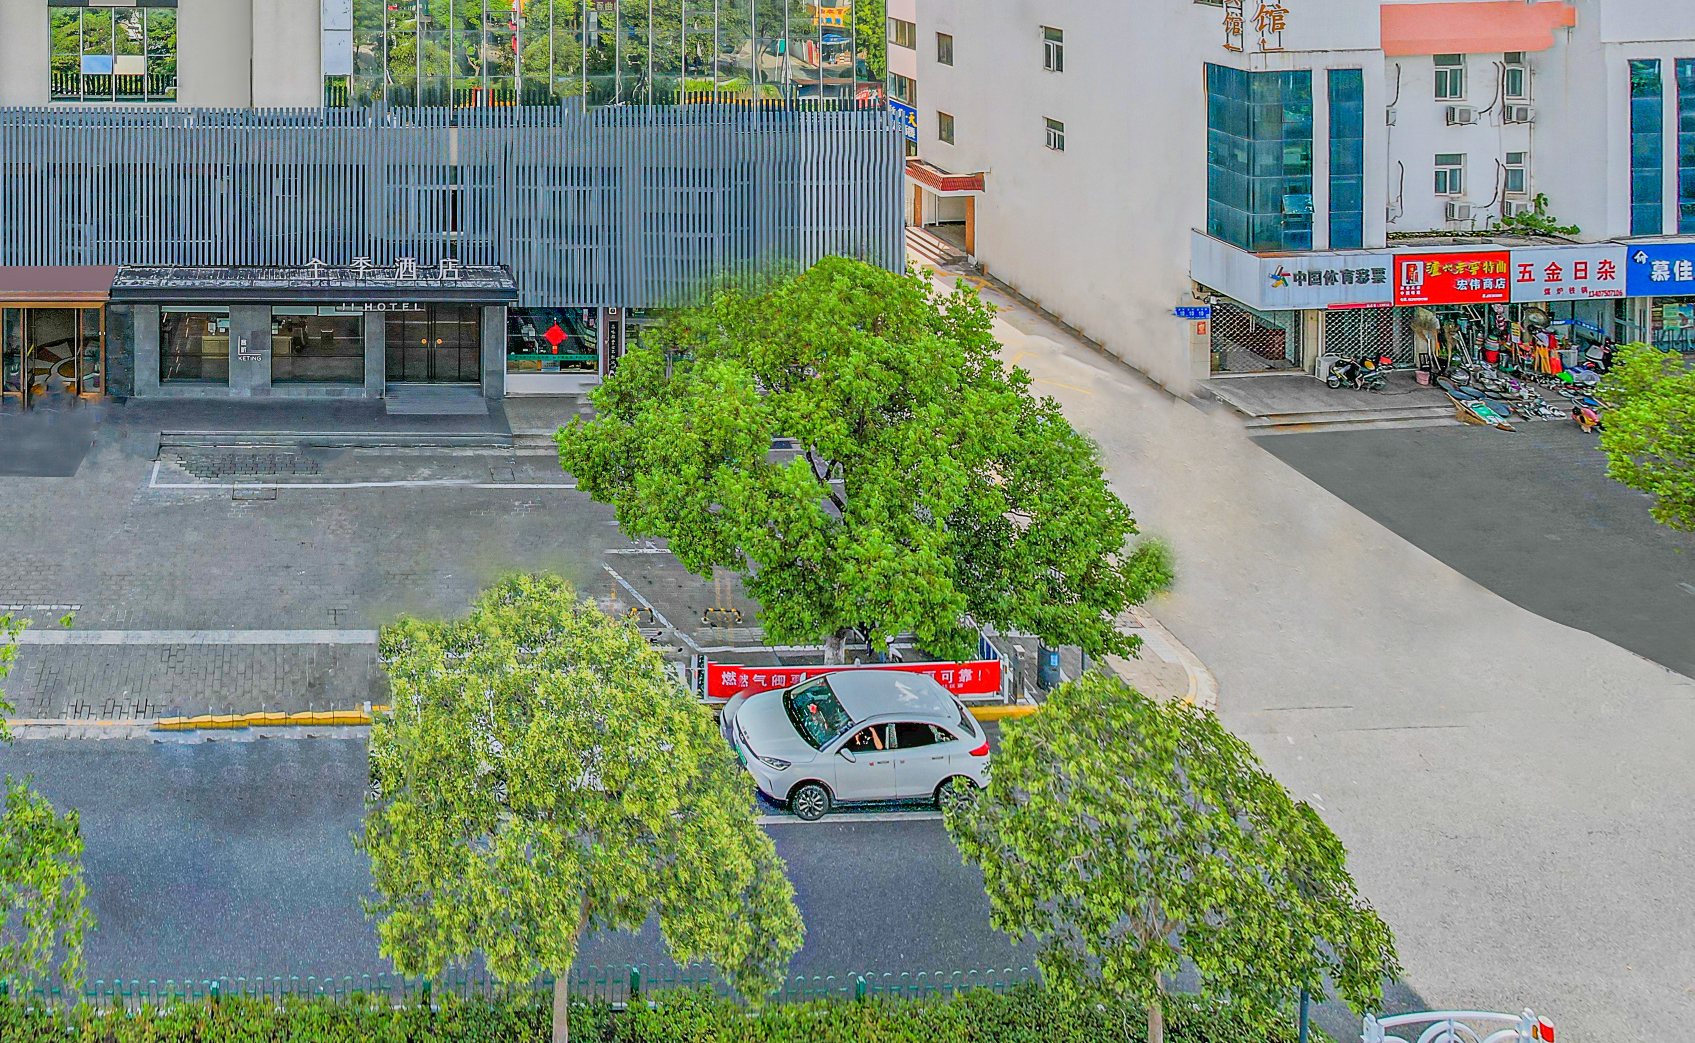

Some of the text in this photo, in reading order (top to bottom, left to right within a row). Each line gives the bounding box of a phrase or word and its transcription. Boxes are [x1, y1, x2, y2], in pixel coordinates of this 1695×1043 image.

[304, 256, 462, 281] 全季酒店
[1293, 266, 1387, 287] 中国体育彩票
[1516, 259, 1616, 282] 五金日杂
[1651, 259, 1693, 282] 慕佳
[1455, 277, 1507, 291] 宏伟商店
[364, 302, 422, 312] HOTEL
